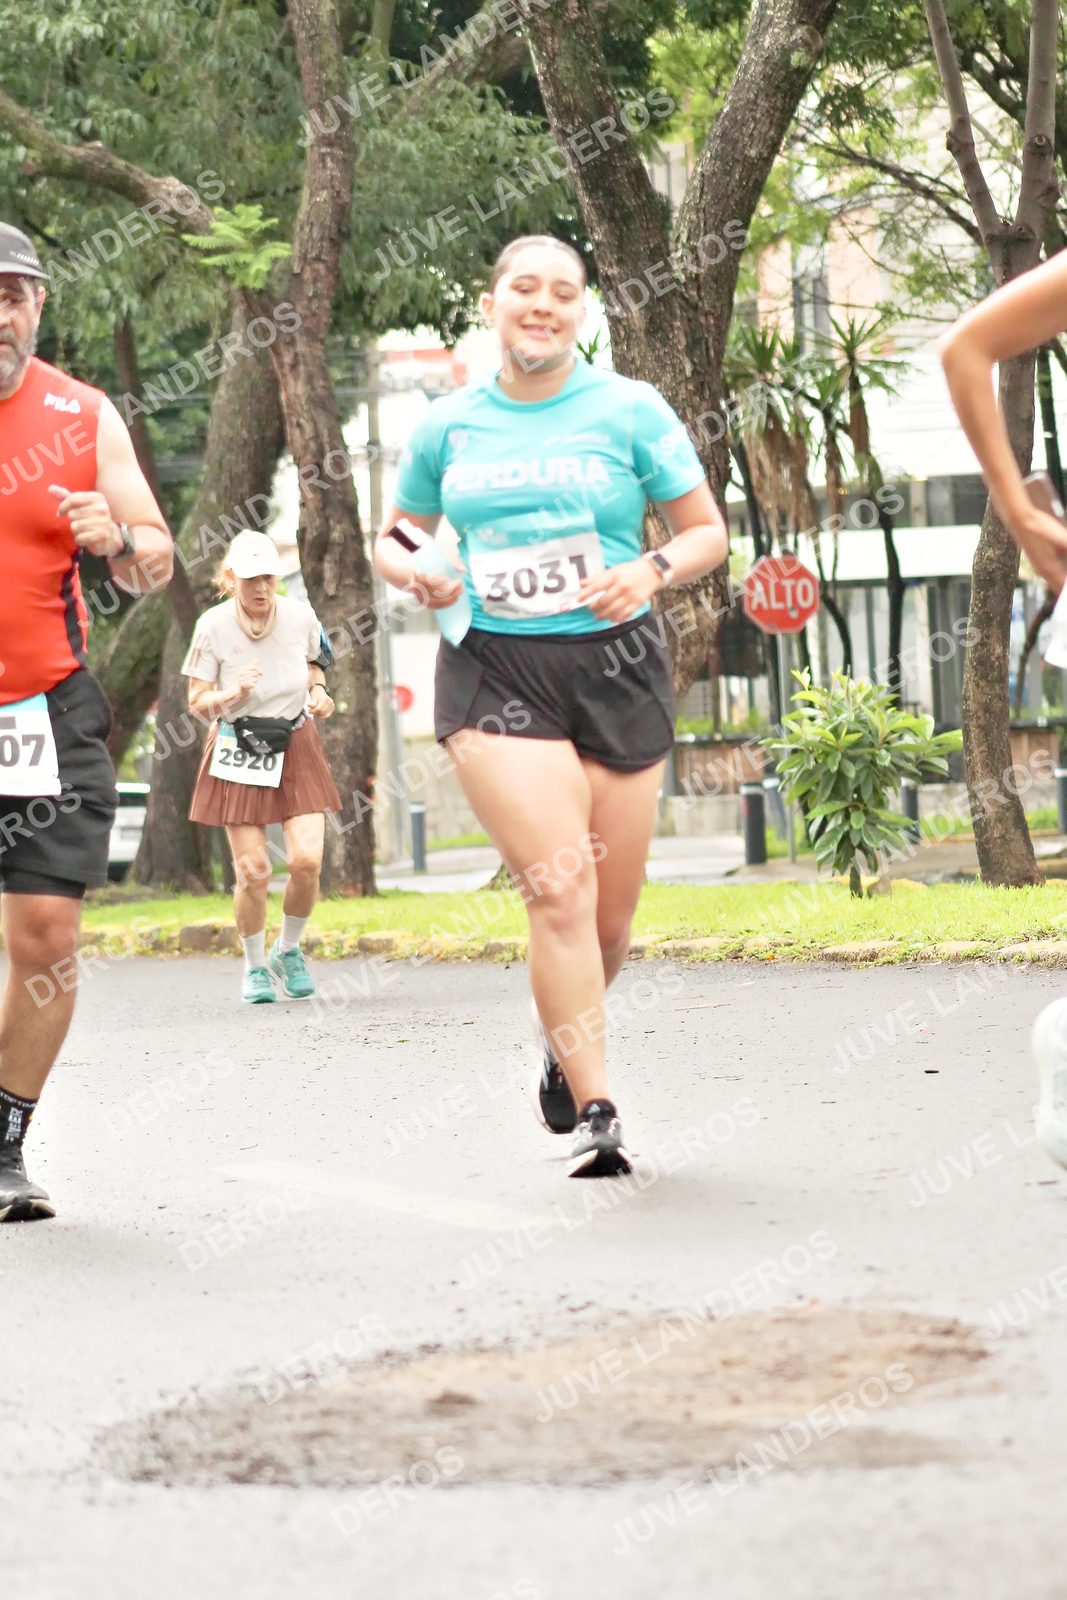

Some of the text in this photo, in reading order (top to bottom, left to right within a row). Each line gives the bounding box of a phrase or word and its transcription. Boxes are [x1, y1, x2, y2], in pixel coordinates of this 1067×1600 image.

[43, 392, 81, 414] FILA
[484, 554, 588, 602] 3031
[751, 577, 814, 611] ALTO
[0, 733, 46, 768] 07
[219, 747, 278, 772] 2920
